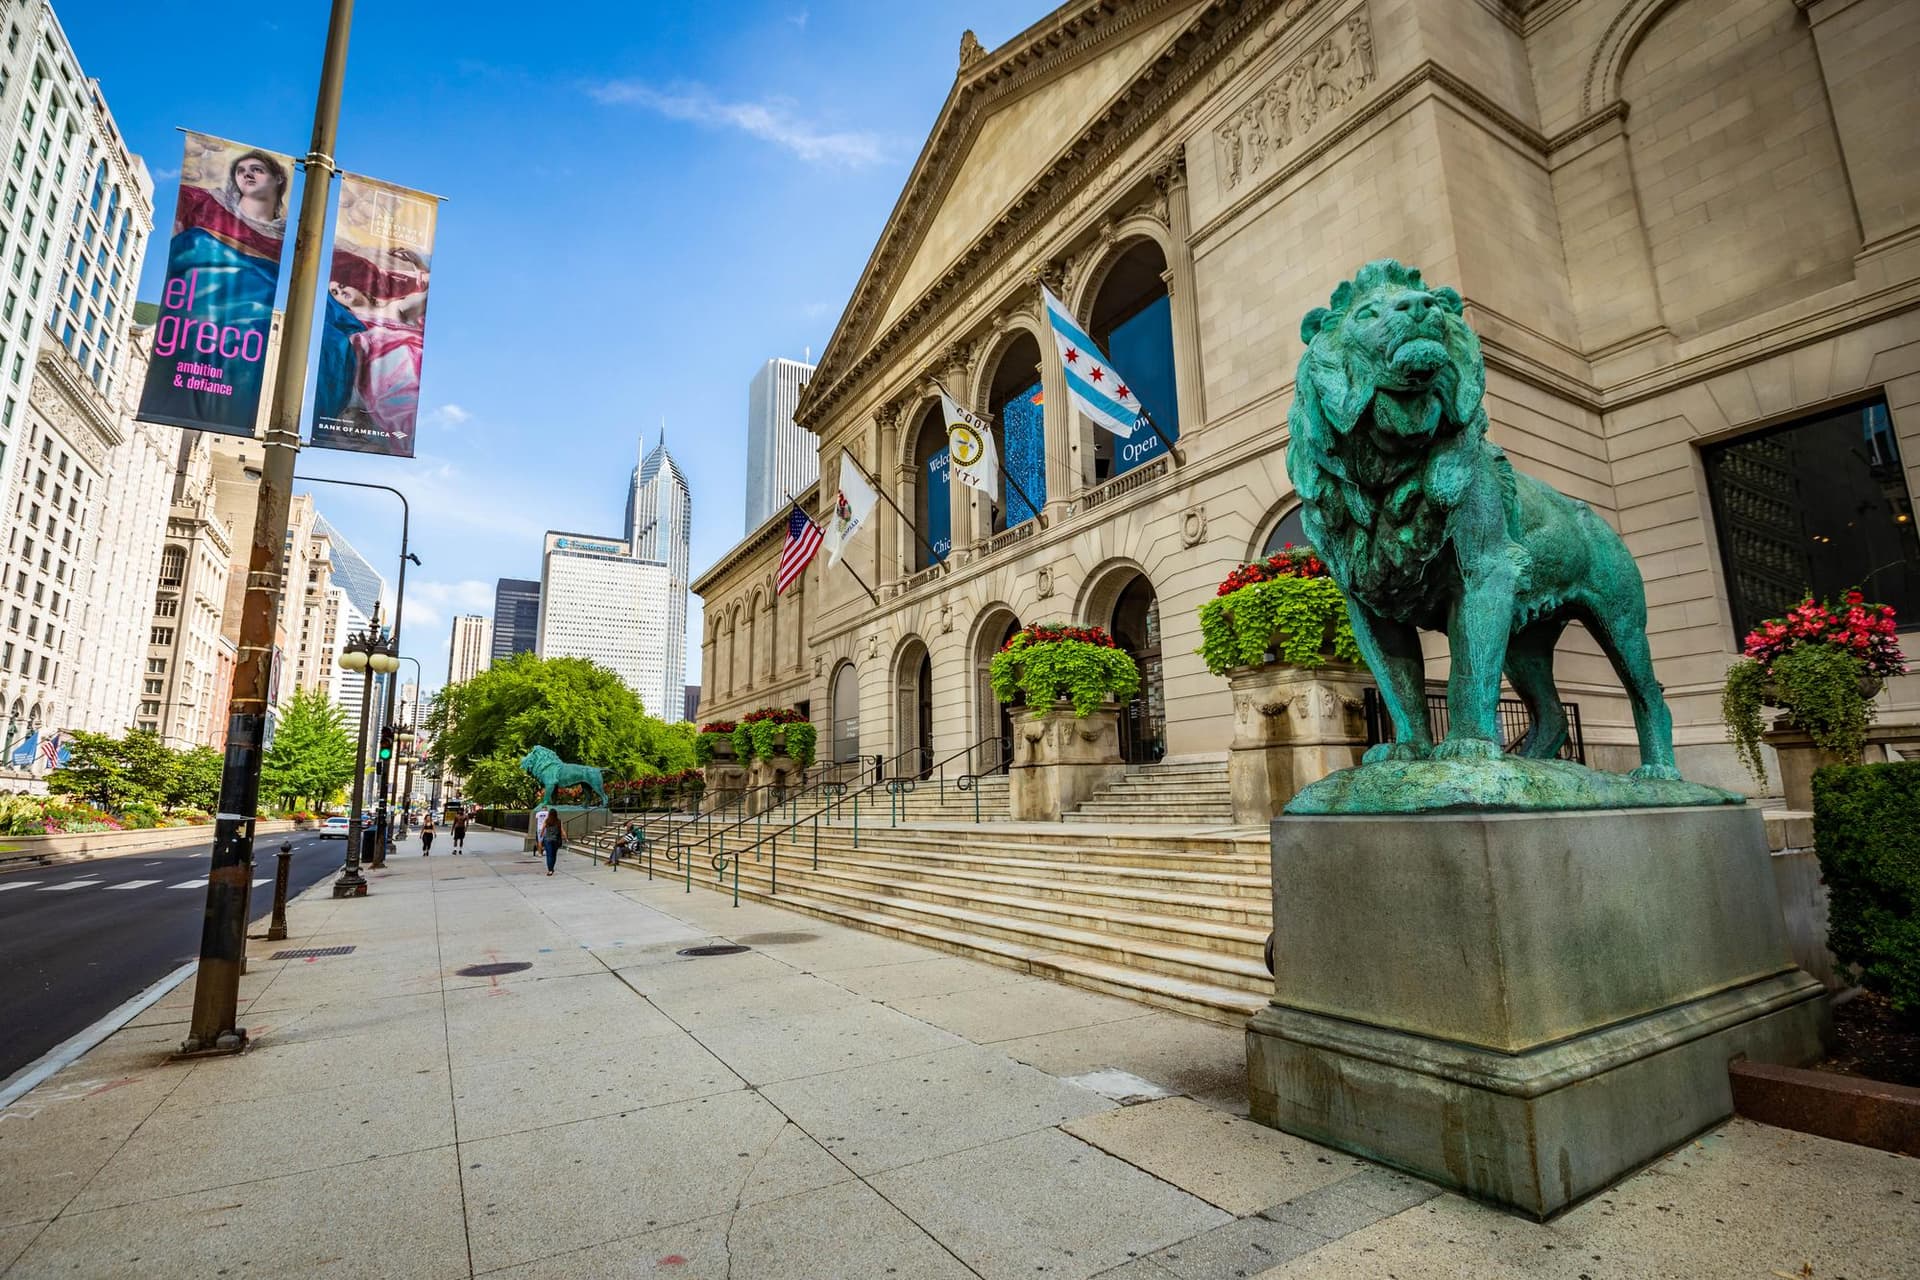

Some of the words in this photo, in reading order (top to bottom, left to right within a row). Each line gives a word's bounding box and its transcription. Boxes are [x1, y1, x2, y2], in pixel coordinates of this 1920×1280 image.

[1027, 231, 1044, 256] OF
[1059, 161, 1121, 226] CHICAGO
[165, 268, 198, 311] el
[155, 315, 263, 362] greco
[176, 361, 223, 379] ambition
[173, 374, 183, 388] &
[186, 376, 233, 396] defiance
[318, 423, 341, 431] BANK
[355, 428, 390, 438] AMERICA
[956, 407, 990, 433] COOK
[1123, 435, 1157, 461] Open
